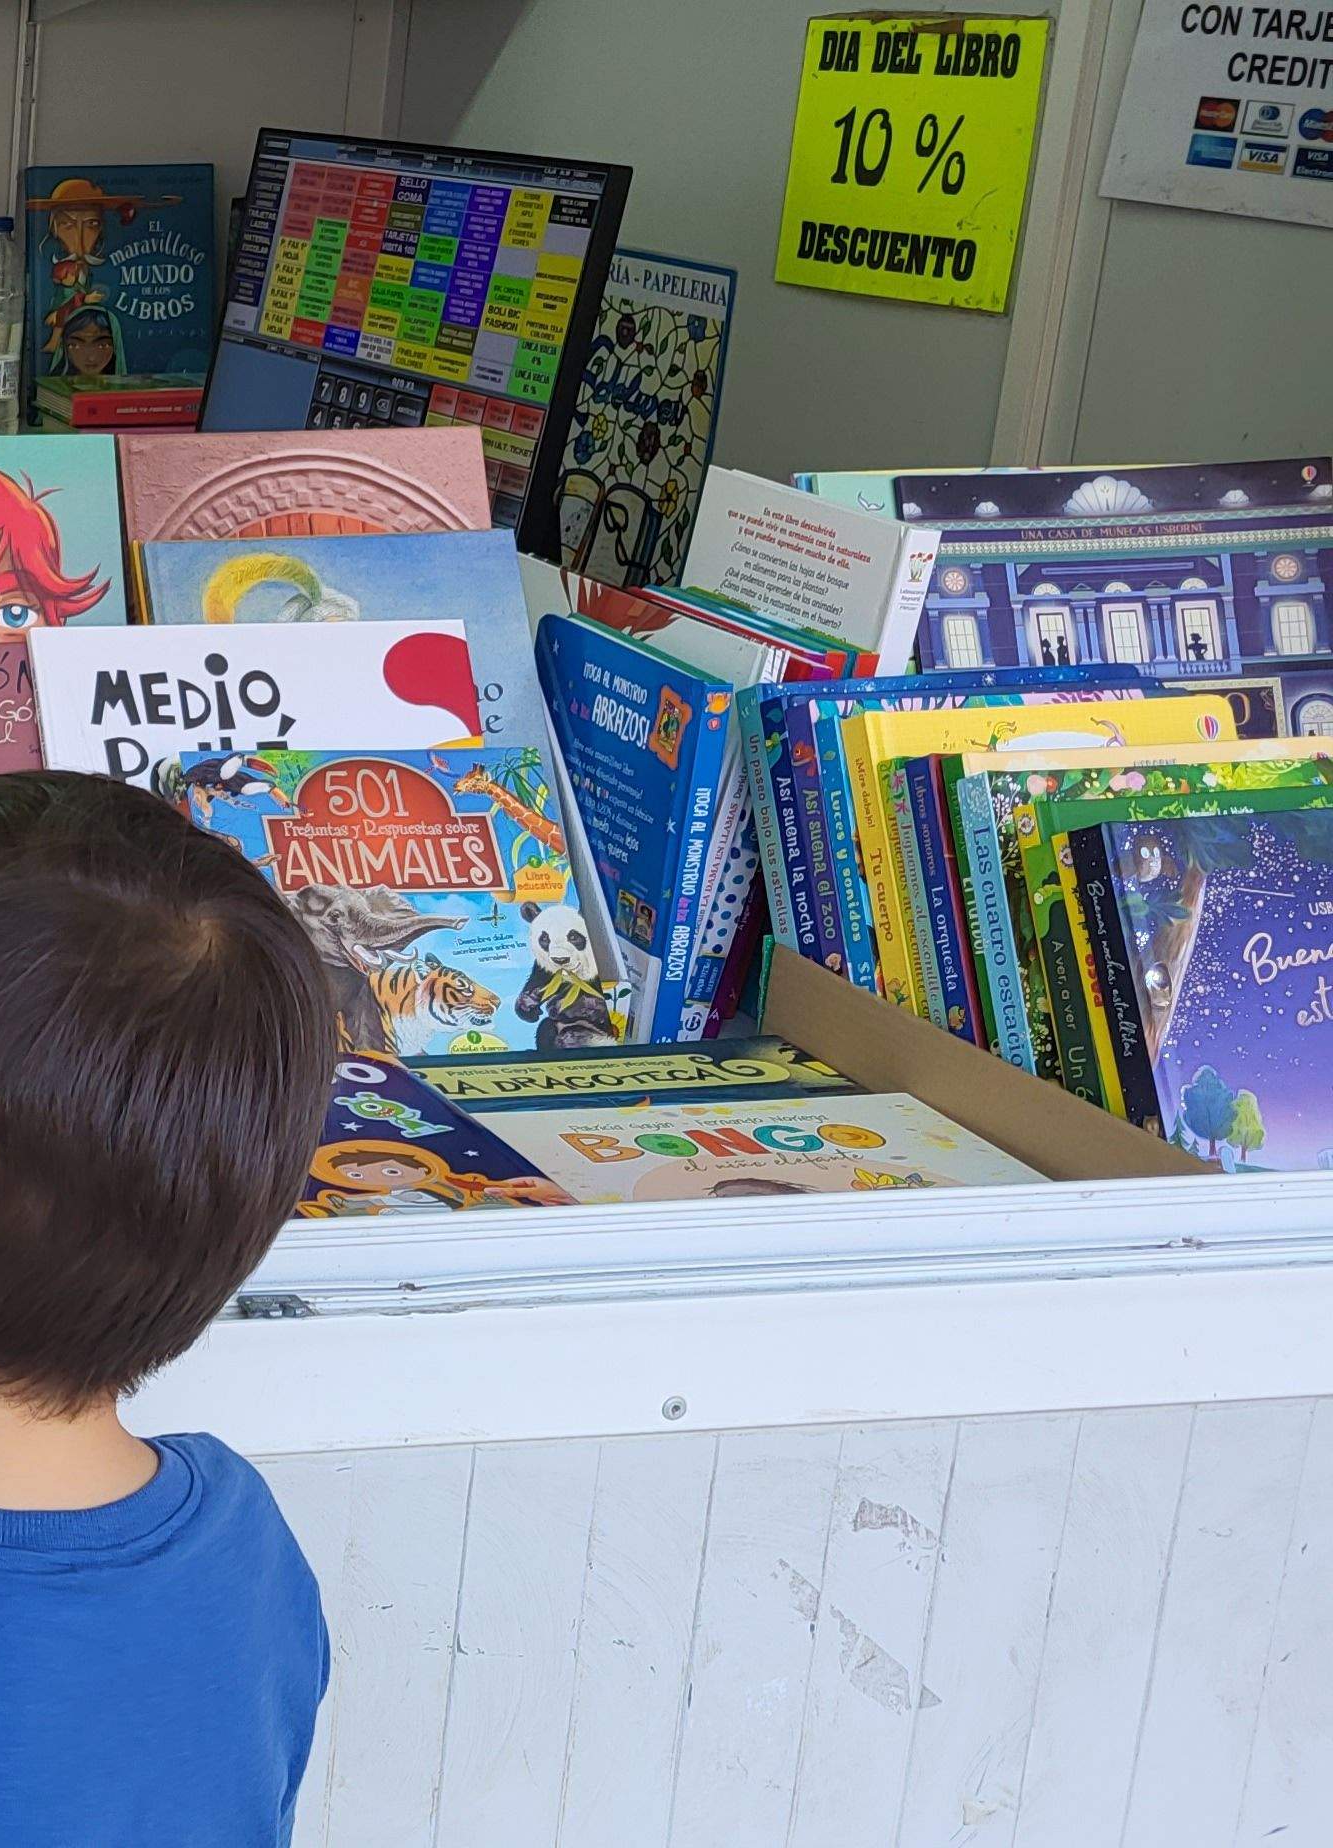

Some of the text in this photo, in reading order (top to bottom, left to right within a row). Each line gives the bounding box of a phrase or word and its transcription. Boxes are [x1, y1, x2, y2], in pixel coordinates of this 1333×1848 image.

[1181, 4, 1239, 36] CON
[819, 31, 1020, 78] DIA DEL LIBRO
[831, 106, 966, 195] 10 %
[1246, 150, 1282, 164] VISA
[1306, 150, 1330, 163] VISA
[149, 221, 163, 233] EL
[109, 230, 205, 268] maravilloso
[798, 221, 978, 282] DESCUENTO
[119, 264, 195, 286] MUNDO
[116, 294, 196, 321] LIBROS
[1021, 528, 1043, 540] UNA
[1048, 527, 1077, 540] CASA
[1081, 527, 1096, 539] DE
[1155, 523, 1205, 536] USBORNE
[749, 734, 761, 755] Un
[324, 770, 410, 819] 501
[753, 759, 767, 801] paseo
[283, 820, 349, 838] Preguntas
[445, 820, 480, 834] sobre
[759, 805, 772, 838] bajo
[285, 836, 493, 886] ANIMALES
[525, 870, 551, 882] Libro
[776, 776, 815, 946] Así suena la noche
[517, 880, 563, 890] educativo
[770, 868, 789, 935] estrellas
[869, 848, 894, 942] Tu cuerpo
[931, 886, 945, 909] La
[973, 825, 1007, 967] Las cuatro
[936, 914, 958, 992] orquesta
[557, 1123, 887, 1163] BONGO
